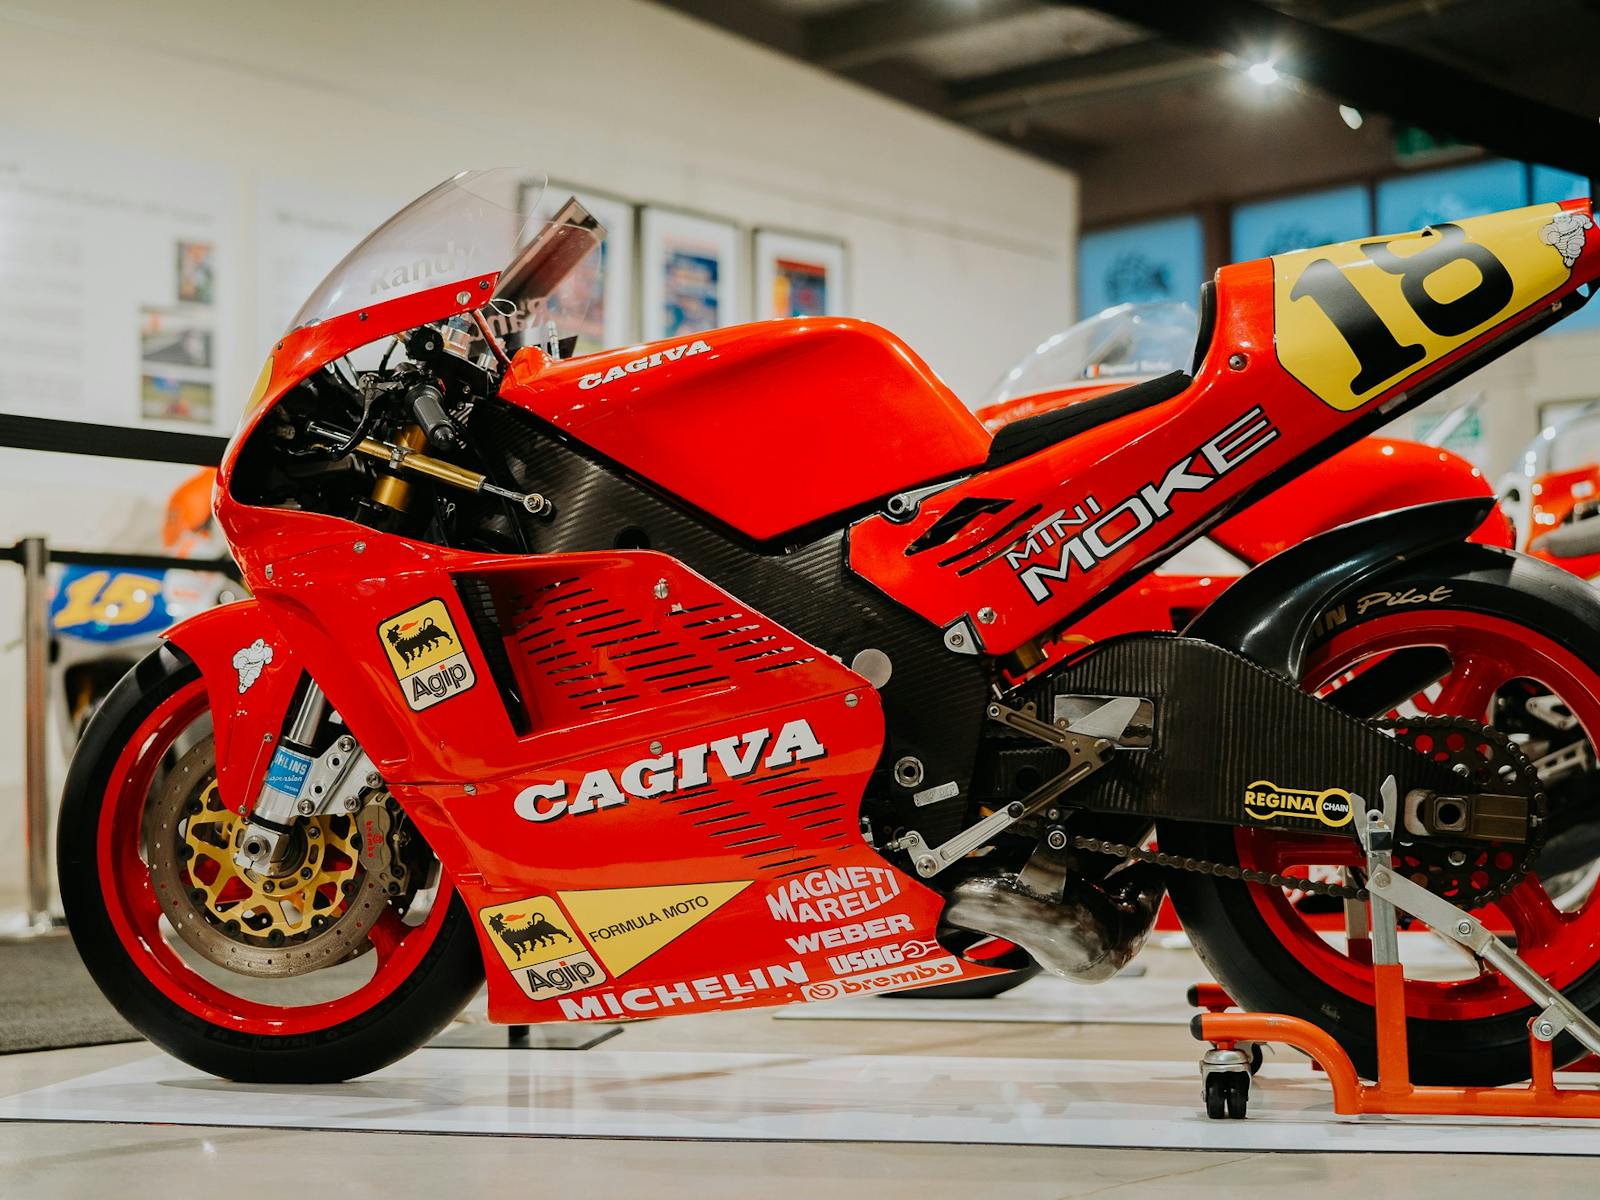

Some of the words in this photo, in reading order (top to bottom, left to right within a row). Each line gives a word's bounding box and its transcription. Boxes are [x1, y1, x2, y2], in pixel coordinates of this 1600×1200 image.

[1290, 223, 1514, 396] 18
[577, 340, 712, 390] CAGIVA
[1019, 405, 1280, 604] MOKE
[1005, 495, 1102, 571] MINI
[53, 570, 162, 628] 15
[1357, 586, 1454, 615] Pilot
[412, 663, 467, 702] Agip
[513, 718, 825, 823] CAGIVA
[1244, 791, 1315, 812] REGINA
[1322, 802, 1349, 813] CHAIN
[766, 866, 900, 910] MAGNETI
[766, 875, 900, 923] MARELLI
[588, 912, 662, 943] FORMULA
[661, 895, 710, 920] MOTO
[785, 913, 915, 955] WEBER
[526, 960, 596, 993] Agip
[827, 942, 905, 976] USAG
[842, 963, 956, 993] brembo
[557, 961, 810, 1021] MICHELIN
